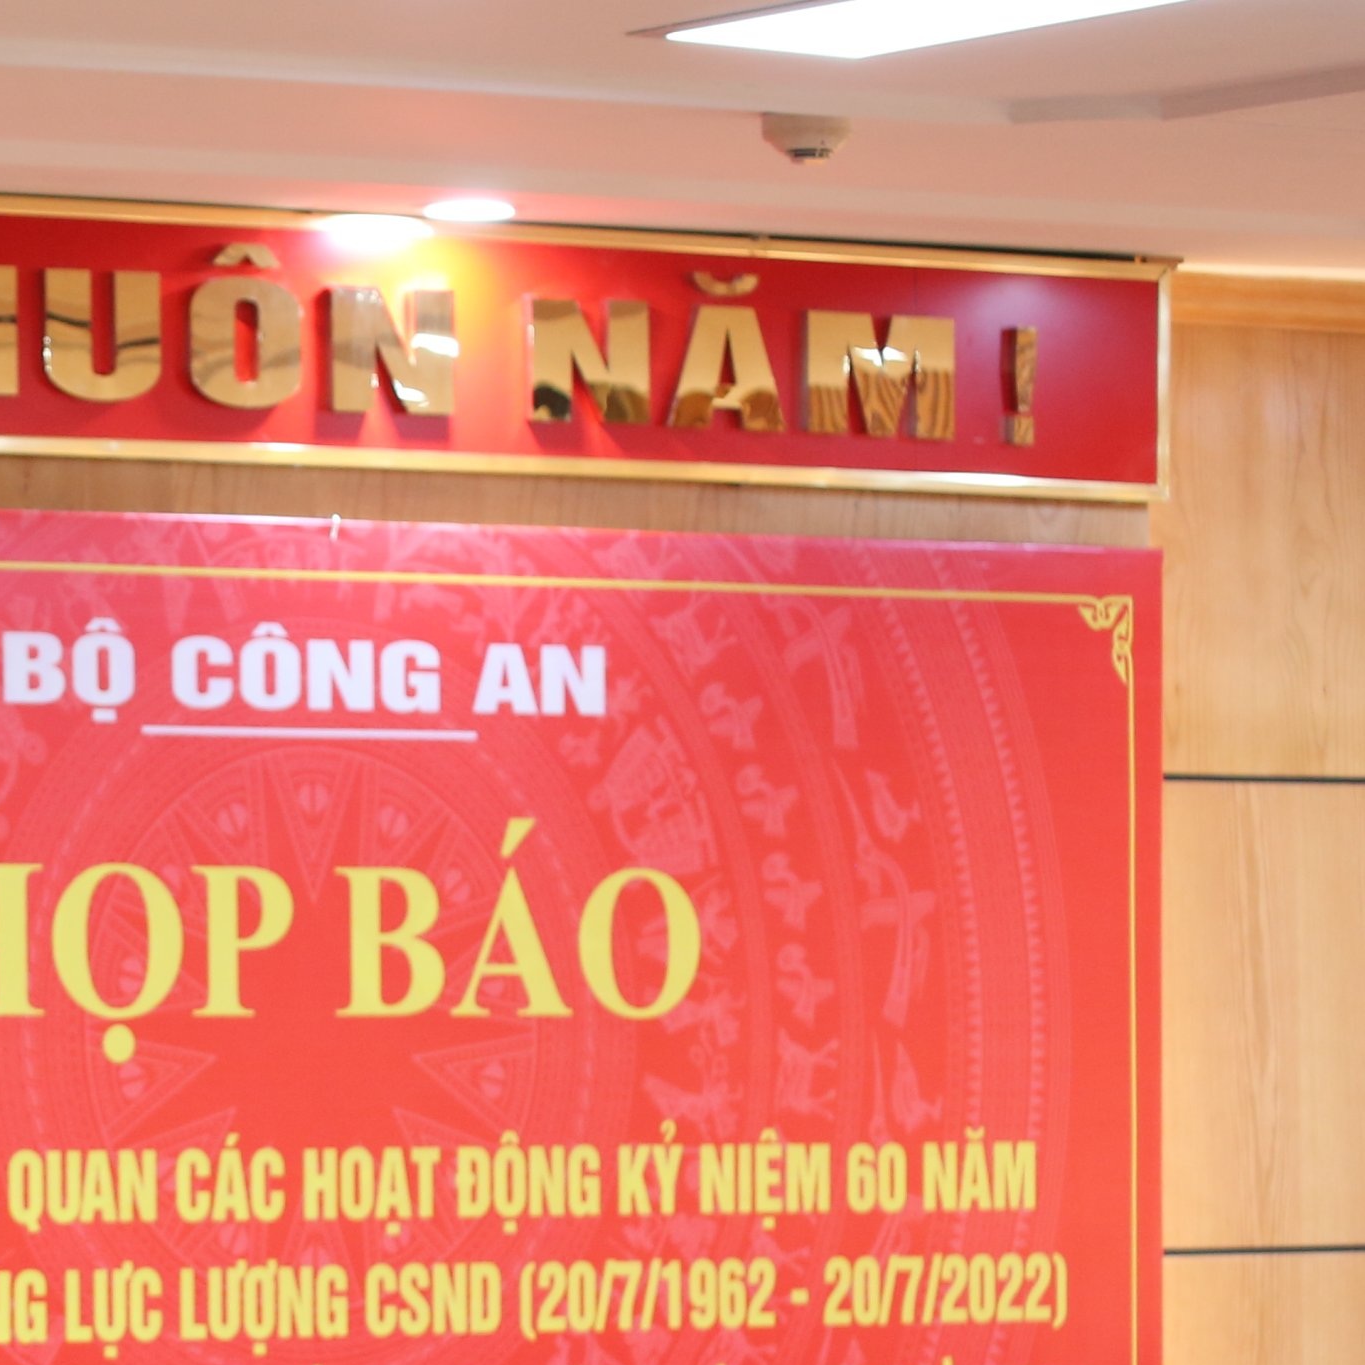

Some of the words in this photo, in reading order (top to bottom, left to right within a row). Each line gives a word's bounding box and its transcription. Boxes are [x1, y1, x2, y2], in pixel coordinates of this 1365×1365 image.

[527, 271, 956, 441] NĂM
[1000, 325, 1037, 446] !
[2, 617, 135, 722] BỘ
[172, 622, 440, 713] CÔNG
[473, 643, 606, 716] AN
[336, 818, 700, 1019] BÁO
[8, 1149, 157, 1233] QUAN
[175, 1133, 285, 1222] CÁC
[303, 1147, 440, 1234] HOẠT
[454, 1131, 600, 1234] ĐỘNG
[618, 1120, 683, 1216] KỶ
[699, 1129, 830, 1229] NIỆM
[847, 1142, 907, 1213] 60
[923, 1127, 1036, 1212] NĂM
[66, 1261, 162, 1358] LỰC
[180, 1259, 348, 1356] LƯỢNG
[365, 1262, 501, 1337] CSND
[520, 1257, 775, 1340] (20/7/1962
[824, 1253, 1067, 1328] 20/7/2022)
